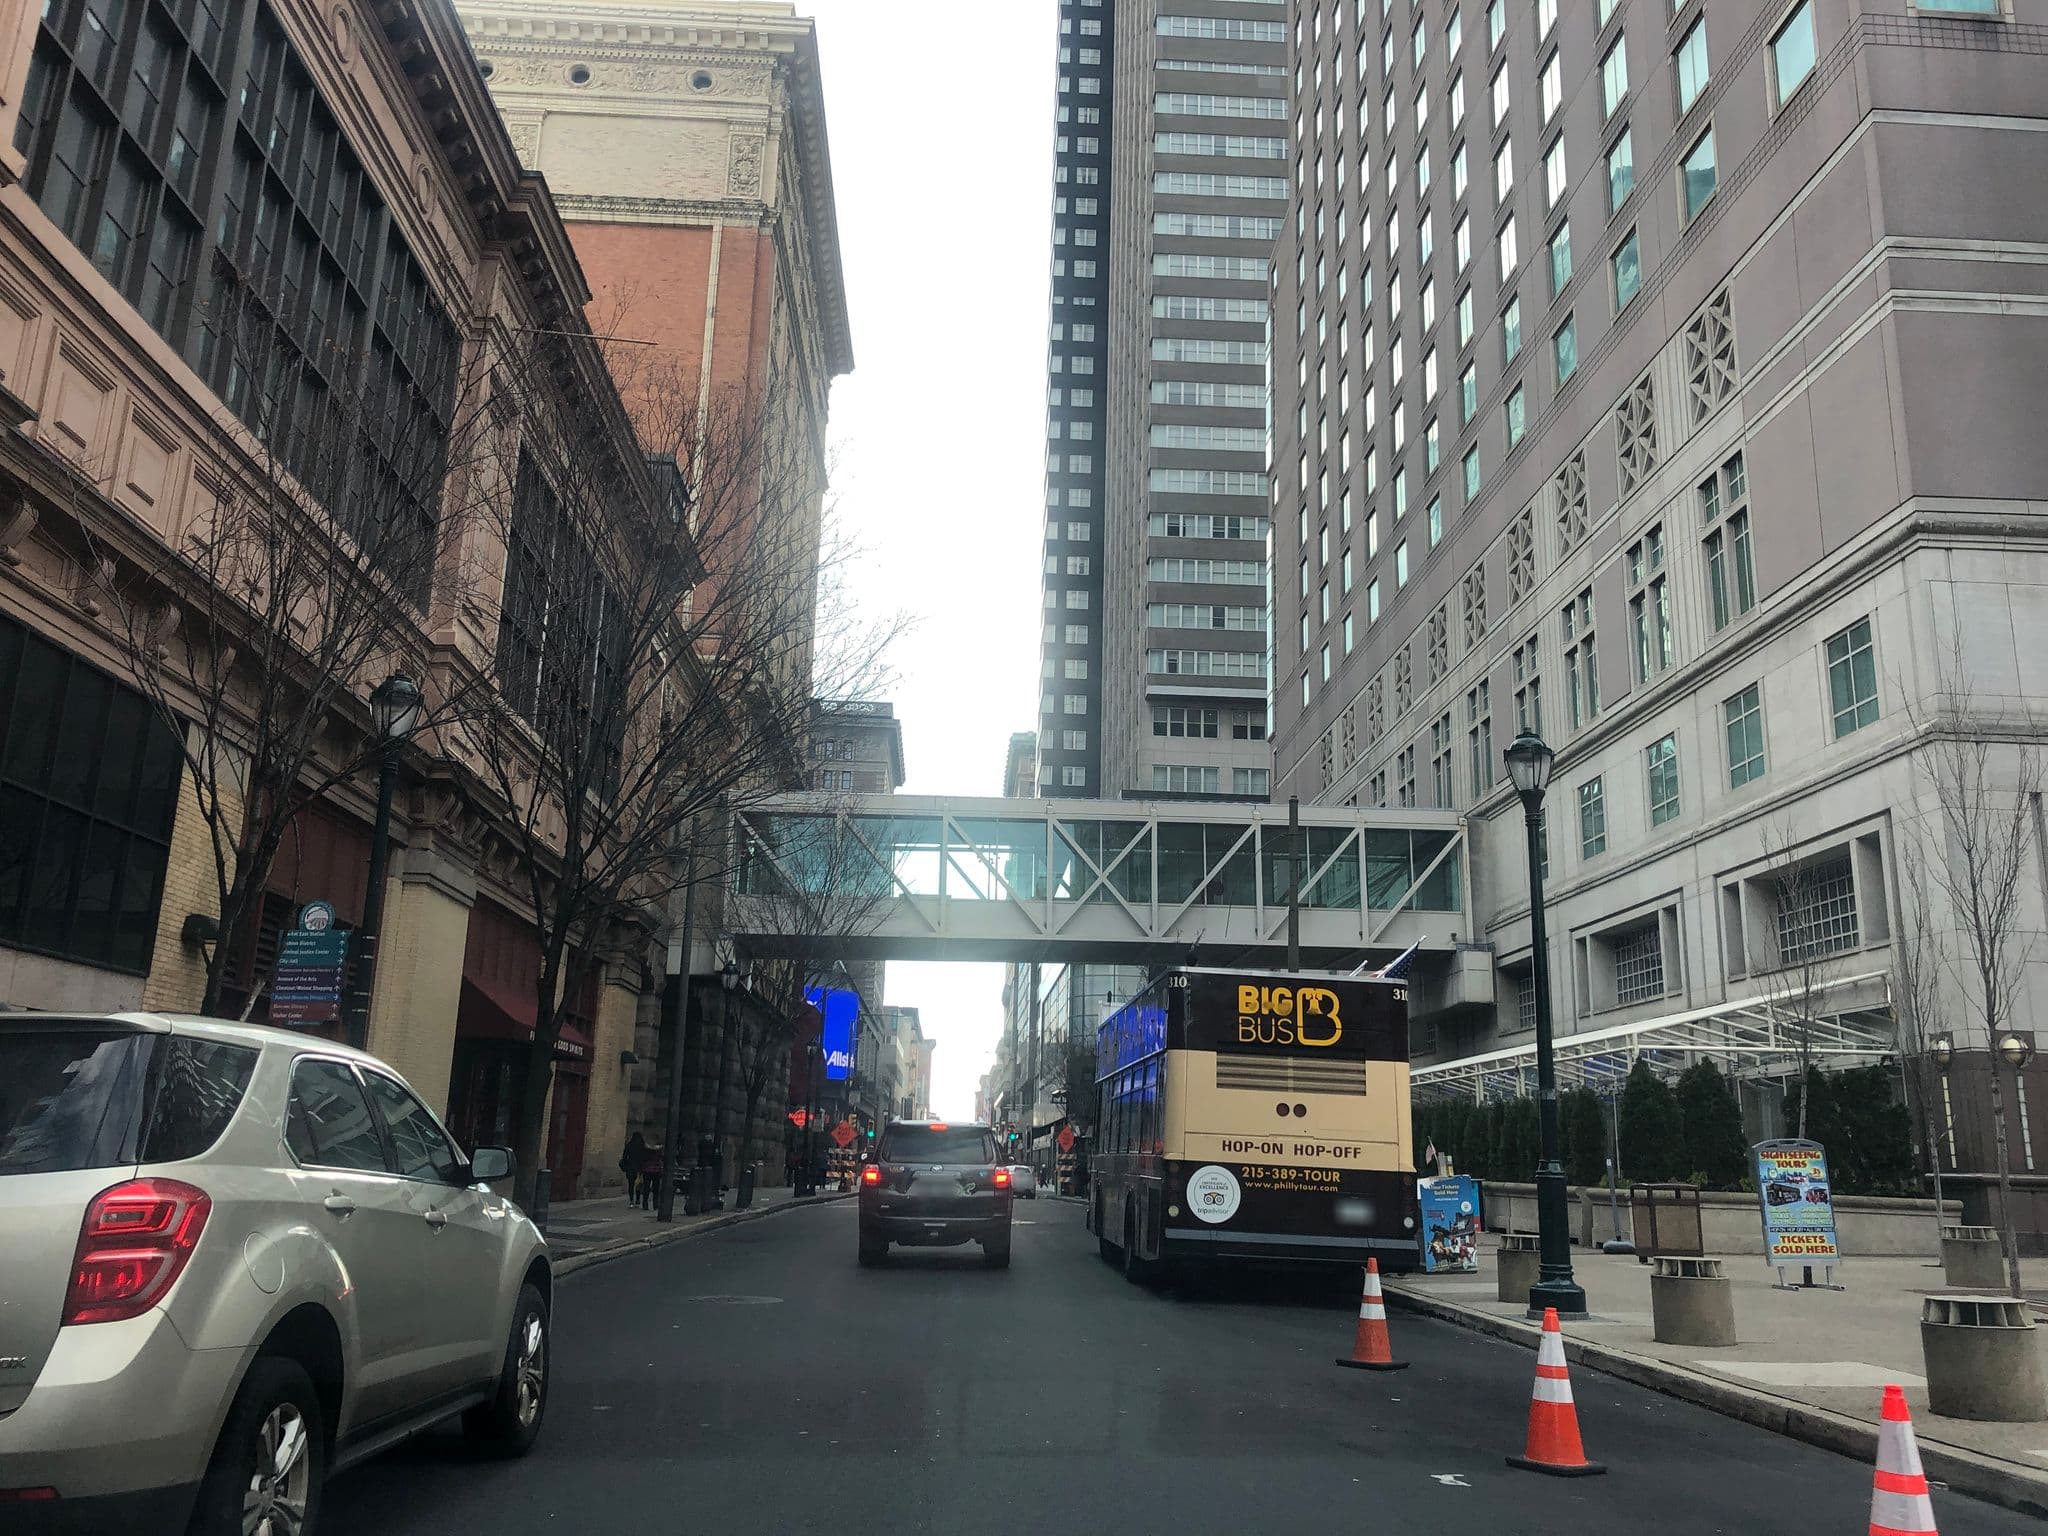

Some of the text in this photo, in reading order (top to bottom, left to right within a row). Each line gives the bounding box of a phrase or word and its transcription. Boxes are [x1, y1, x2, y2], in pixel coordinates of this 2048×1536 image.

[1238, 984, 1294, 1016] BIG
[1238, 1016, 1294, 1044] BUS
[1222, 1140, 1362, 1159] HOP-ON HOP-OFF
[1760, 1151, 1820, 1159] SIGHTSEEING
[1776, 1160, 1807, 1168] TOURS
[1241, 1166, 1341, 1183] 215-389-TOUR
[1244, 1181, 1339, 1193] www.phillytour.com
[1780, 1235, 1826, 1244] TICKETS
[1773, 1244, 1836, 1254] SOLD HERE
